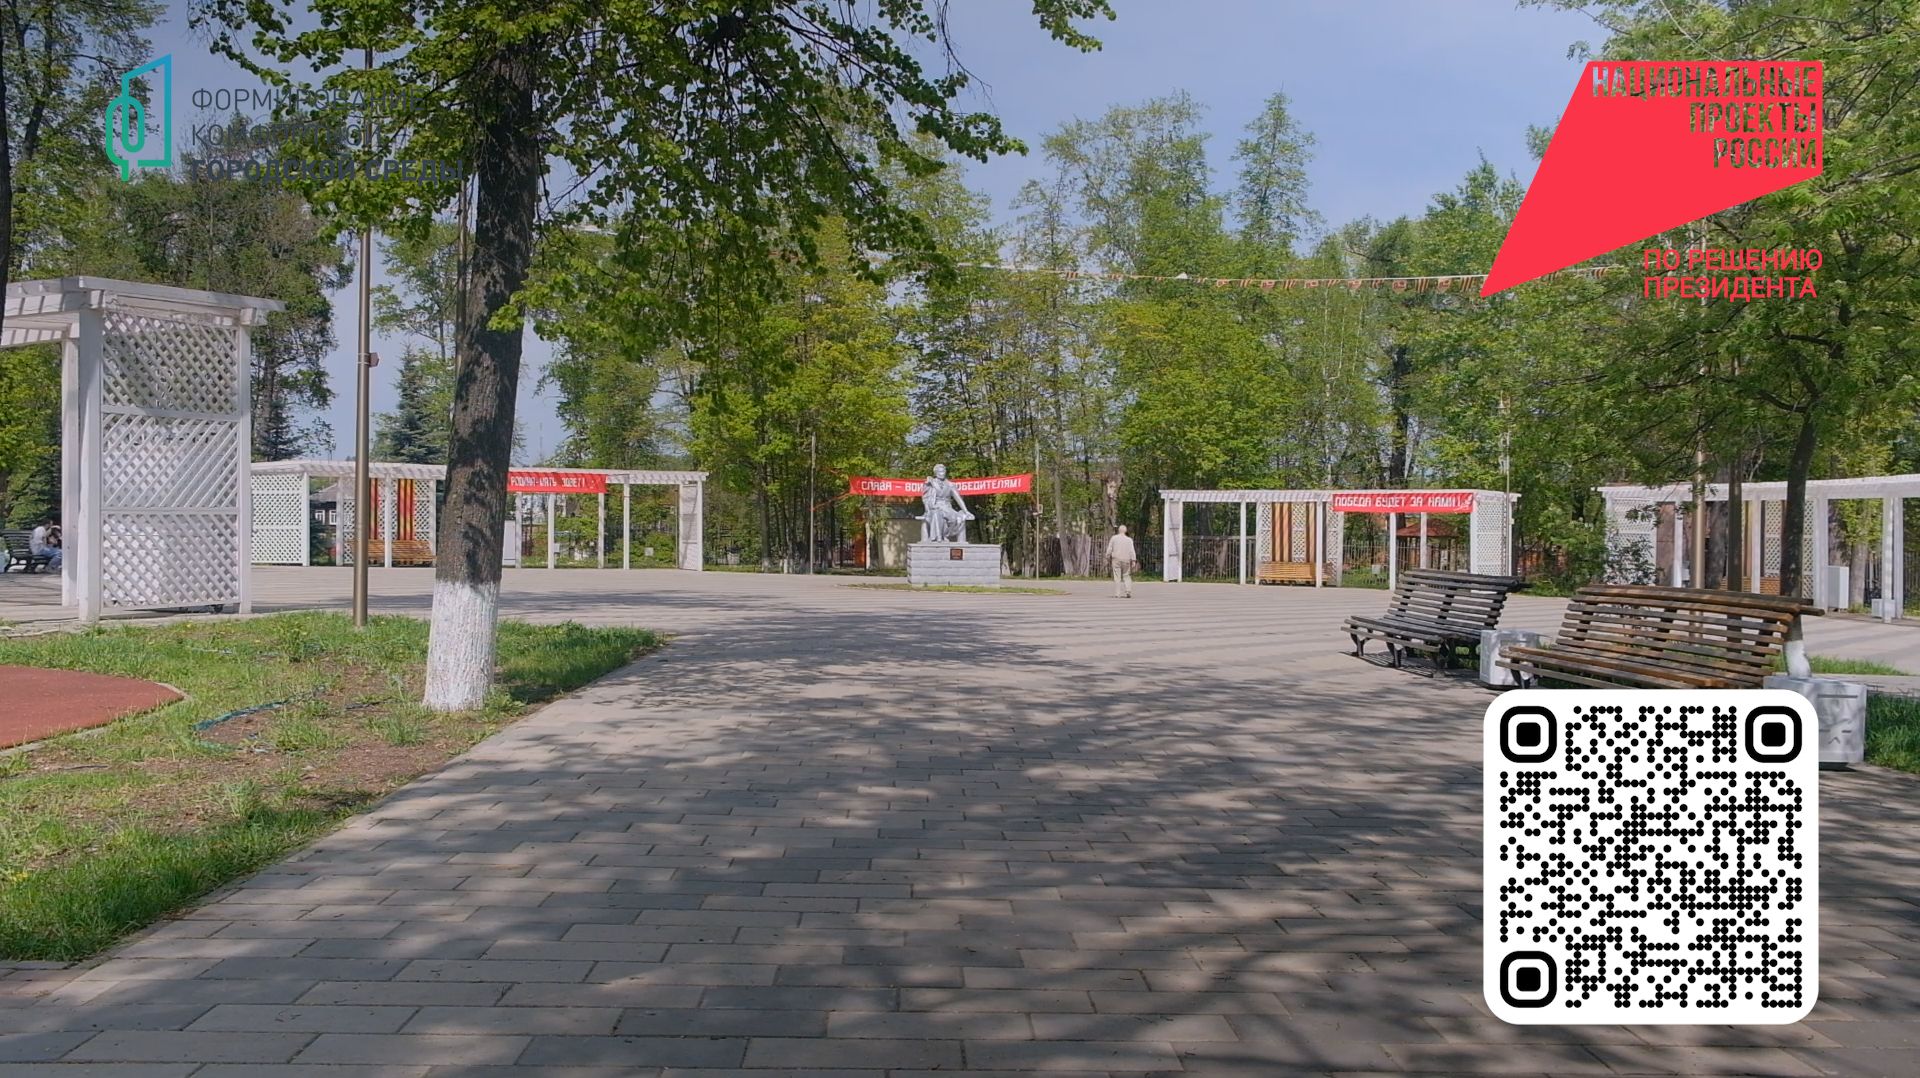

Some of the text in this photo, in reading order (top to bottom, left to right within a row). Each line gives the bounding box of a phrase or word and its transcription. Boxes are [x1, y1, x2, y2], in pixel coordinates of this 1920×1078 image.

[861, 481, 892, 491] СЛАВА
[954, 478, 1022, 491] ОБЕДИТЕЛЯМ!
[1334, 496, 1372, 507] ПОБЕДА
[1375, 496, 1406, 508] БУДЕТ
[1410, 496, 1423, 507] ЗА
